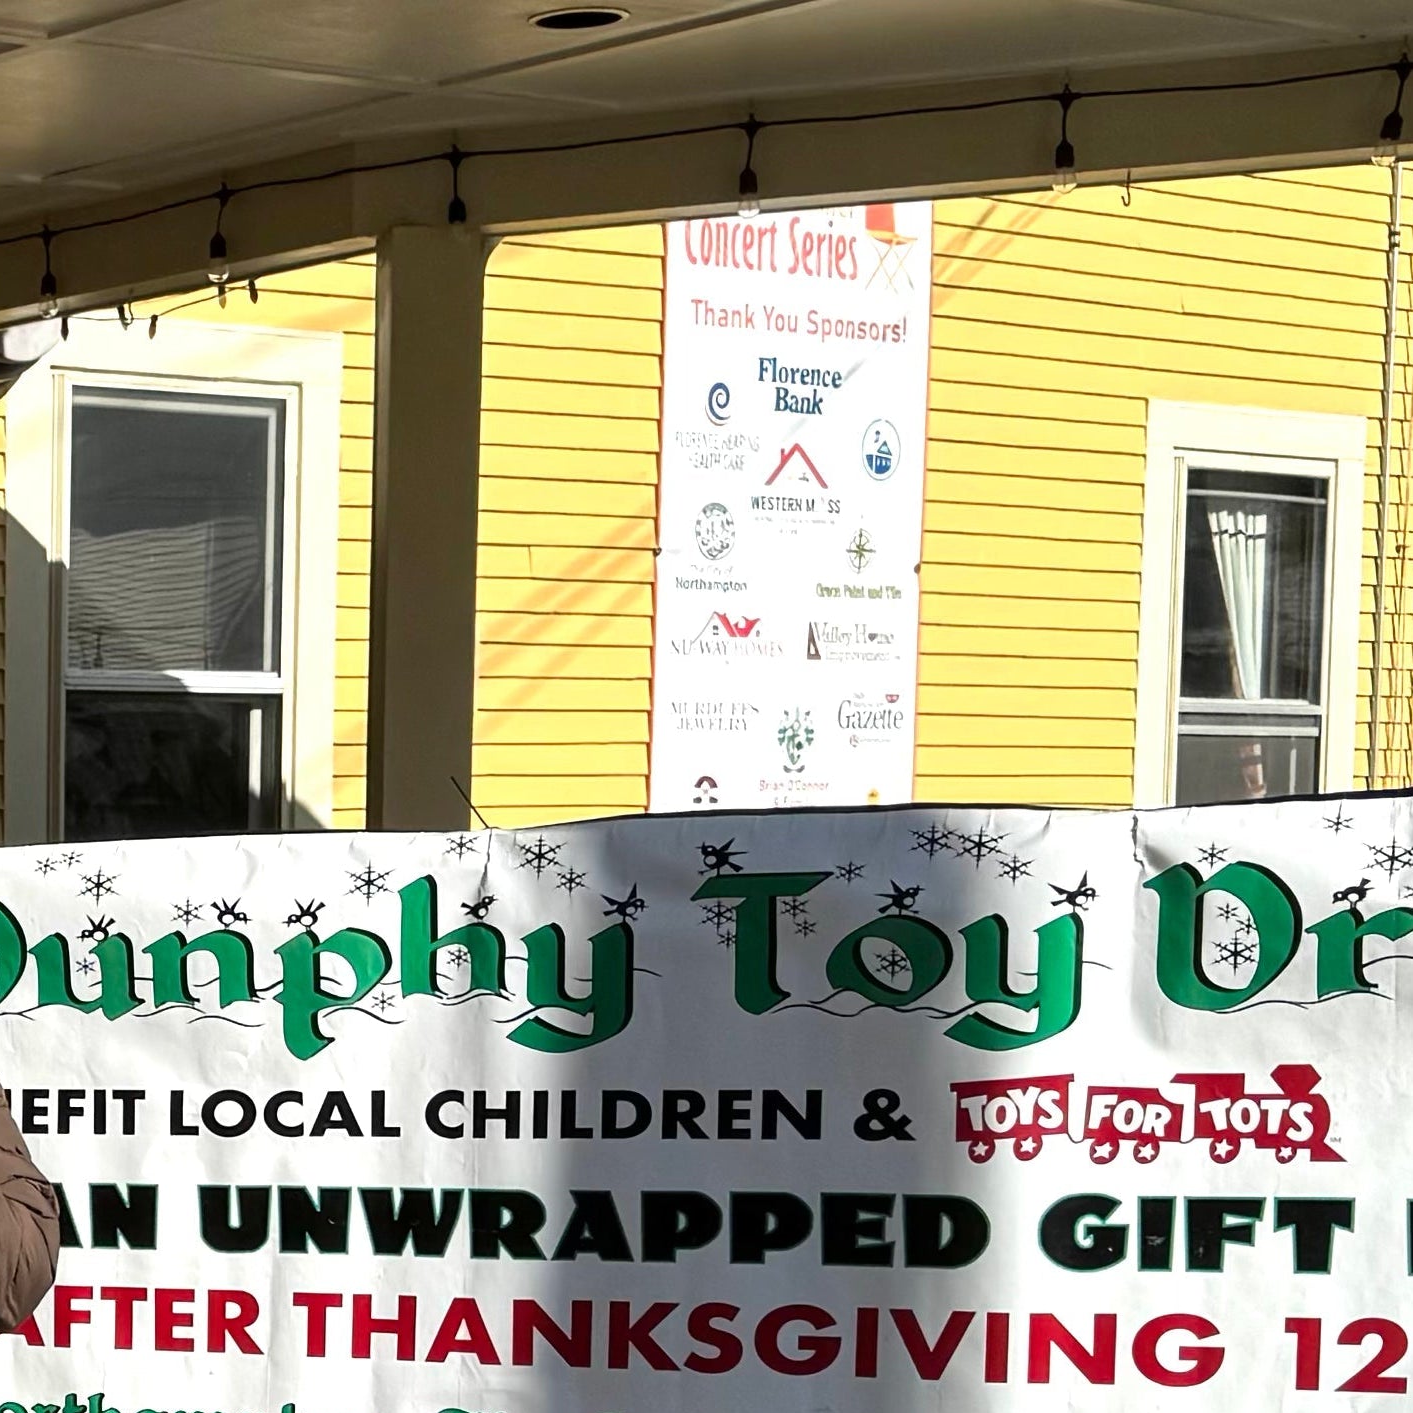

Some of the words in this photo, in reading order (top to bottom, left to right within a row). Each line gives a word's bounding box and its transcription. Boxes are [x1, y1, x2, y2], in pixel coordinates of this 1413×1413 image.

[684, 218, 777, 273] Concert
[788, 216, 858, 280] Series
[691, 298, 756, 330] Thank
[763, 305, 798, 333] You
[806, 309, 908, 343] Sponsors!
[757, 356, 842, 389] Florence
[774, 386, 824, 415] Bank
[751, 496, 803, 513] WESTERN
[805, 498, 841, 514] MSS
[675, 576, 748, 593] Northampton
[838, 699, 904, 730] Gazette
[690, 870, 1085, 1052] Toy
[4, 1088, 147, 1136] EFIT
[169, 1089, 402, 1138] LOCAL
[424, 1088, 824, 1142] CHILDREN
[853, 1087, 916, 1143] &
[960, 1086, 1065, 1133] TOYS
[1087, 1101, 1169, 1138] FOR
[1199, 1097, 1315, 1142] TOTS
[197, 1184, 991, 1269] UNWRAPPED
[1038, 1191, 1357, 1276] GIFT
[292, 1291, 1226, 1388] THANKSGIVING
[1284, 1316, 1410, 1395] 12
